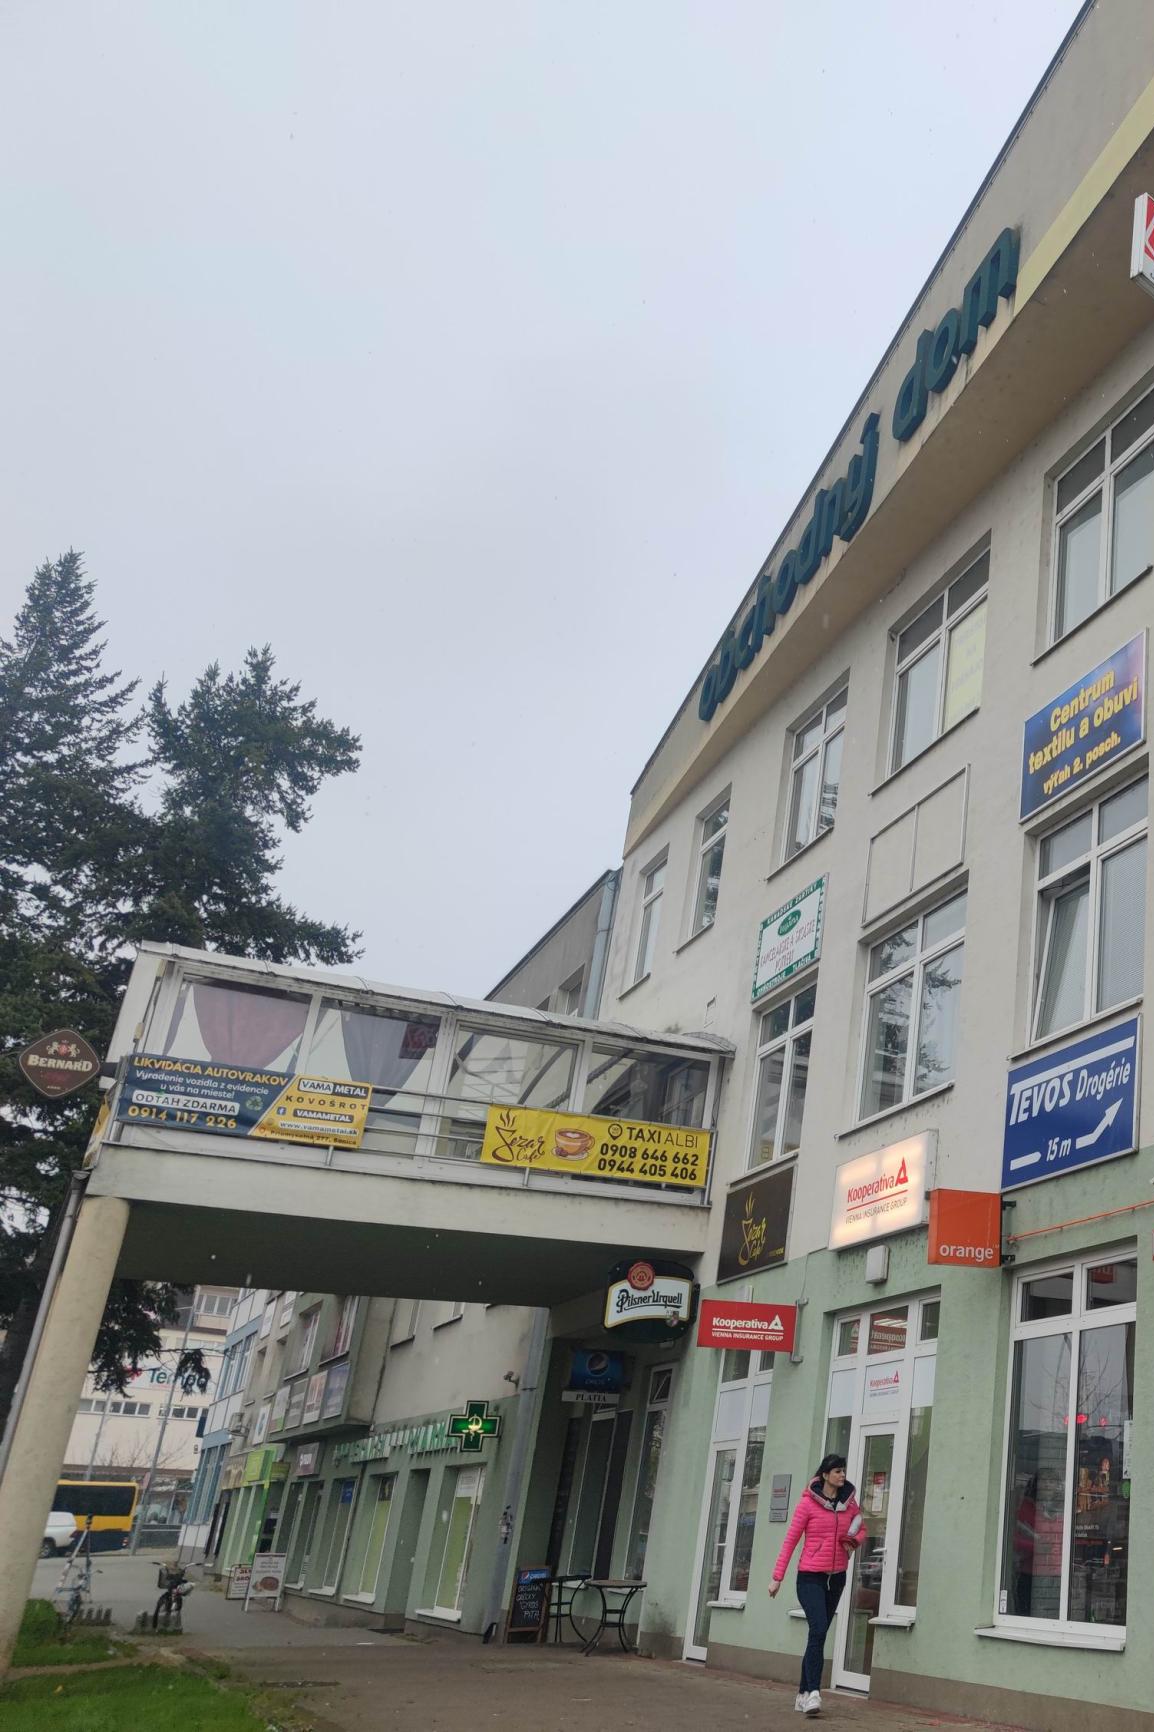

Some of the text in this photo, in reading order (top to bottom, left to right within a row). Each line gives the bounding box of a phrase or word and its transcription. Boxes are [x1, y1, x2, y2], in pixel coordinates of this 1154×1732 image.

[893, 227, 1020, 442] dom
[1050, 670, 1115, 732] Centrum
[1028, 677, 1138, 775] textilu a obuvi
[1085, 731, 1121, 769] posch.
[27, 1053, 93, 1073] BERNARD
[133, 1056, 289, 1087] LIKVIDÁCIA AUTOVRAKOV
[135, 1069, 184, 1084] Vyradenie
[186, 1076, 218, 1089] vozidla
[227, 1082, 269, 1095] evidencie
[168, 1084, 185, 1092] vás
[187, 1087, 199, 1095] na
[302, 1079, 367, 1097] VAMA METAL
[1009, 1057, 1131, 1127] TEVOS Drogérie
[128, 1105, 237, 1129] 0914 117 226
[183, 1098, 236, 1114] ZDARMA
[296, 1109, 352, 1122] VAMAMETAL
[626, 1126, 698, 1149] TAXI ALBI
[600, 1143, 699, 1167] 0908 646 662
[1045, 1138, 1072, 1162] 15 m
[597, 1158, 697, 1181] 0944 405 406
[847, 1173, 895, 1204] Kooperativa
[939, 1244, 994, 1263] orange
[616, 1288, 683, 1313] Pilsner Urquell
[712, 1316, 768, 1331] Kooperativa
[711, 1331, 784, 1342] VIENNA INSURANCE GROUP
